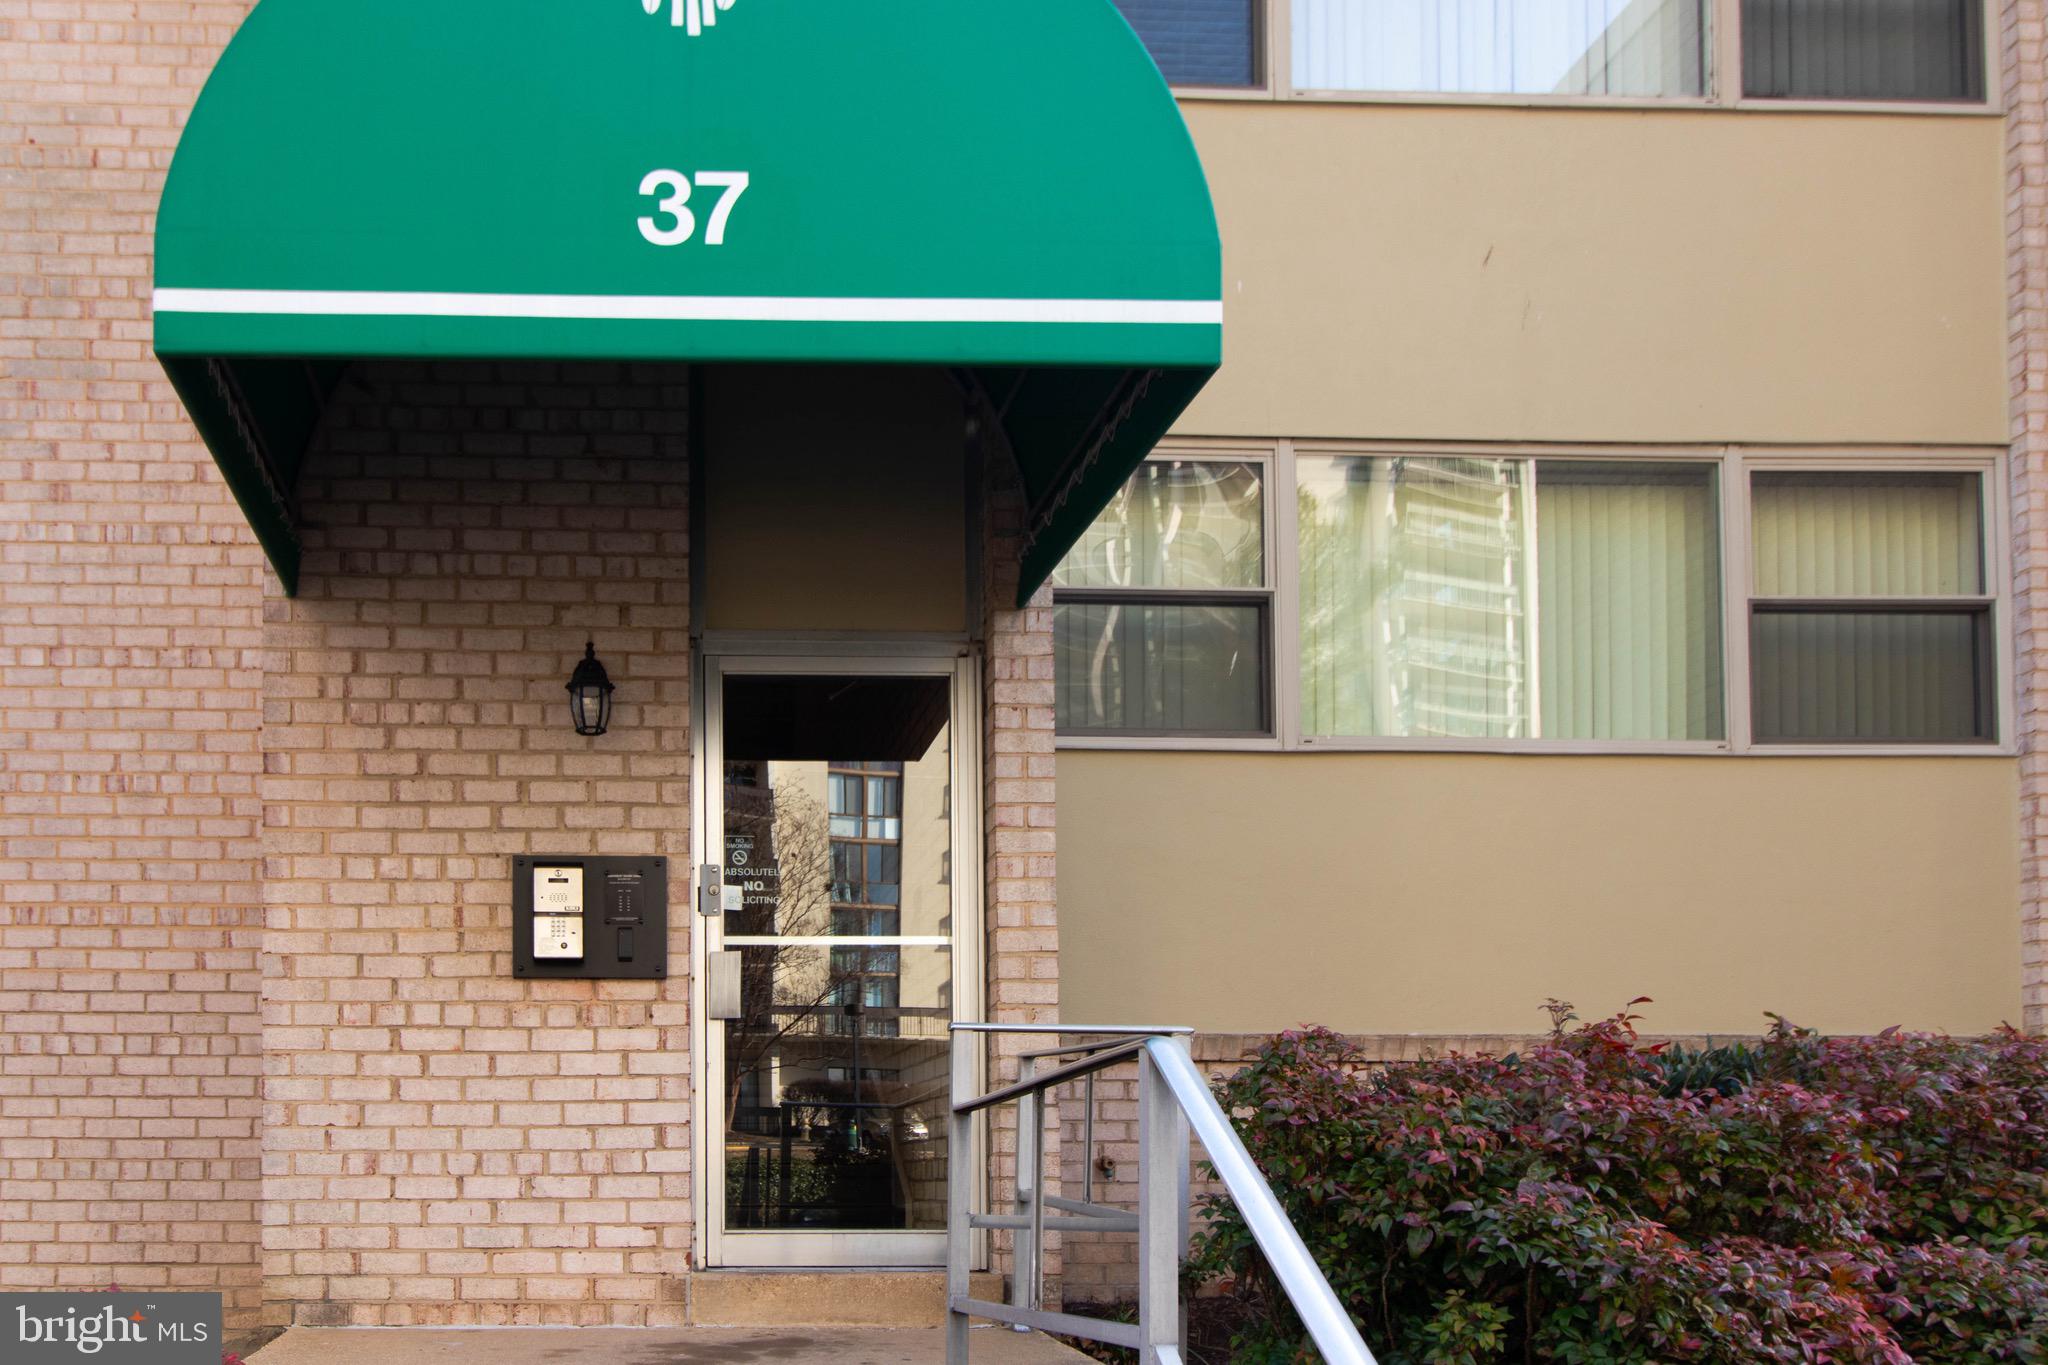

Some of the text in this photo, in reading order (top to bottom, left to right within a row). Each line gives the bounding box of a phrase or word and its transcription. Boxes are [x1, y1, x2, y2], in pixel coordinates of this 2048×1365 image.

[637, 168, 749, 246] 37
[724, 868, 782, 876] ABSOLUTEL
[743, 880, 764, 891] NO
